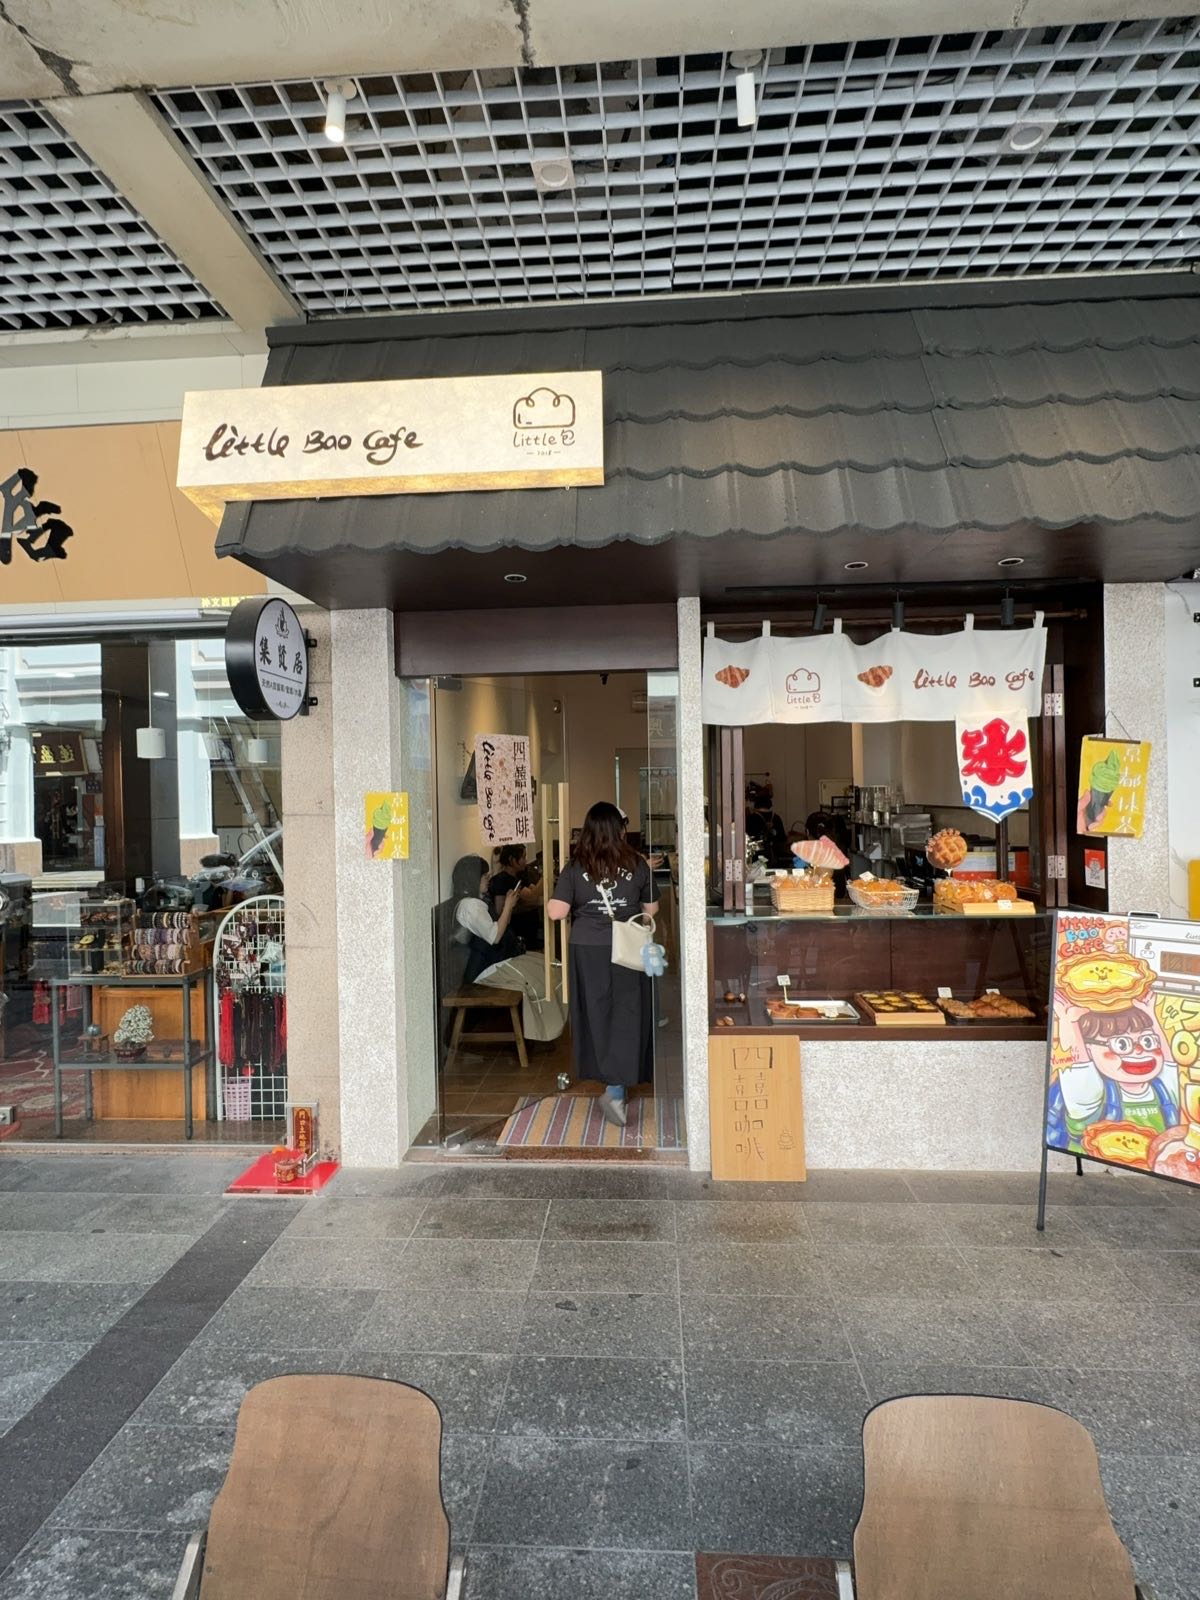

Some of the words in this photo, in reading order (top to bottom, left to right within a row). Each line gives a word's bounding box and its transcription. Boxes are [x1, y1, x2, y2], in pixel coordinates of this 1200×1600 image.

[302, 430, 352, 454] Bao
[363, 426, 423, 466] Cafe
[513, 431, 558, 448] Little
[259, 635, 303, 675] 集贤居
[968, 672, 996, 688] Bao
[1005, 668, 1034, 691] Cafe
[484, 787, 494, 809] Bao
[483, 813, 496, 841] Cafe
